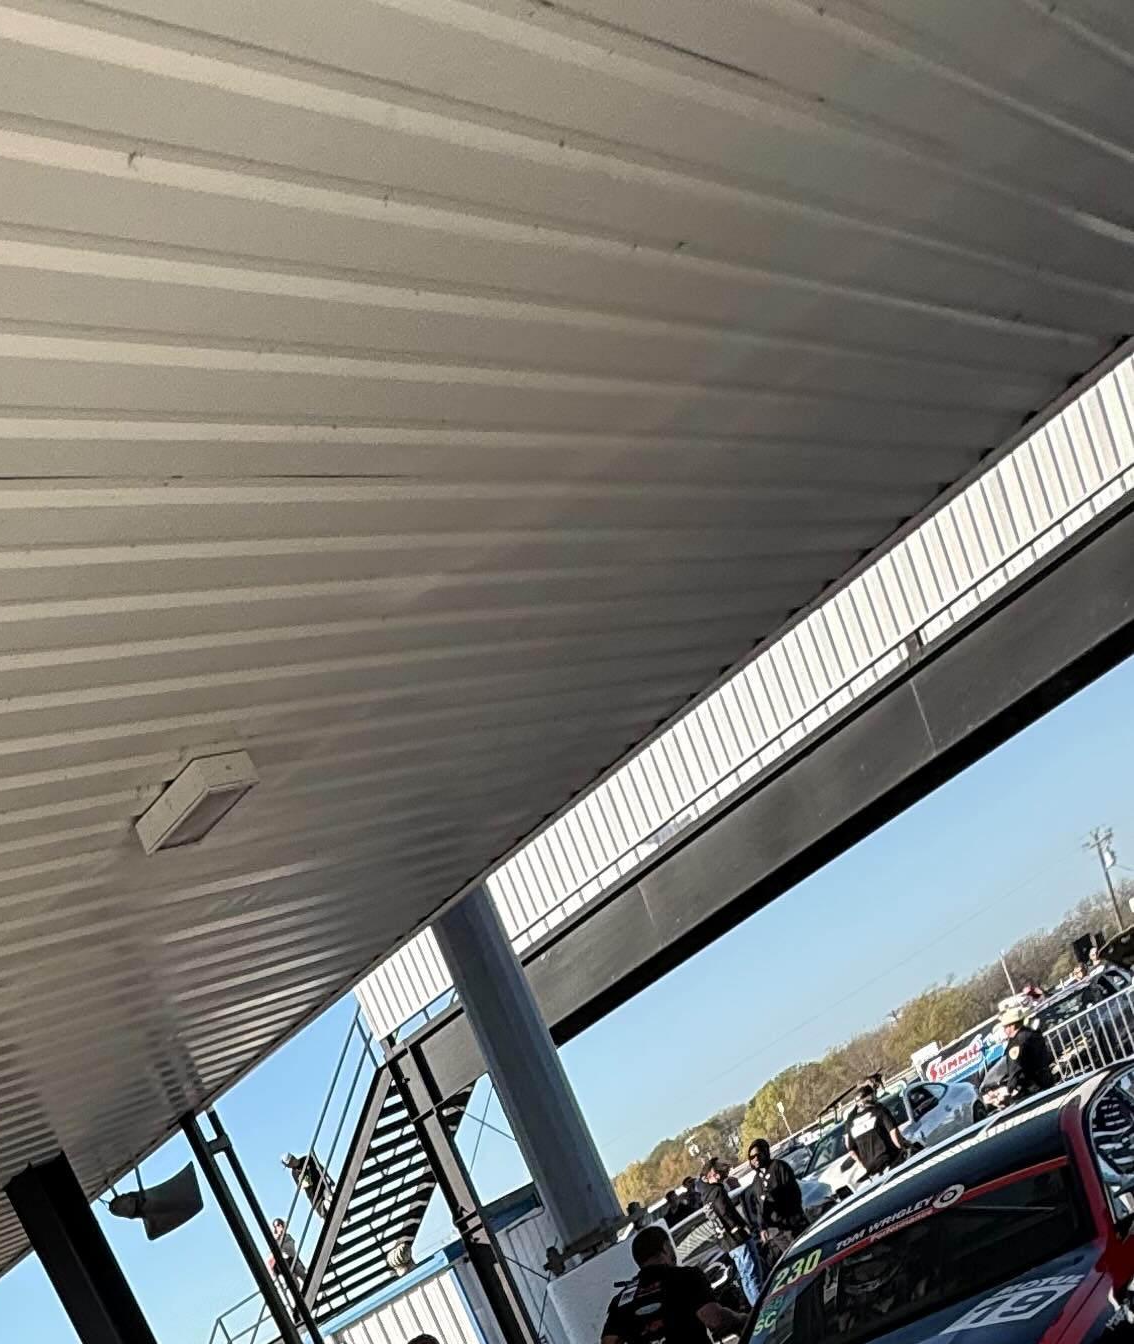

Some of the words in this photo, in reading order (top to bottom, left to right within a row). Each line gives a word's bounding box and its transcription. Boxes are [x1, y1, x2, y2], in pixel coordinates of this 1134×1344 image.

[835, 1228, 866, 1250] TOM
[866, 1197, 935, 1241] WRIGLEY
[772, 1248, 823, 1294] 230
